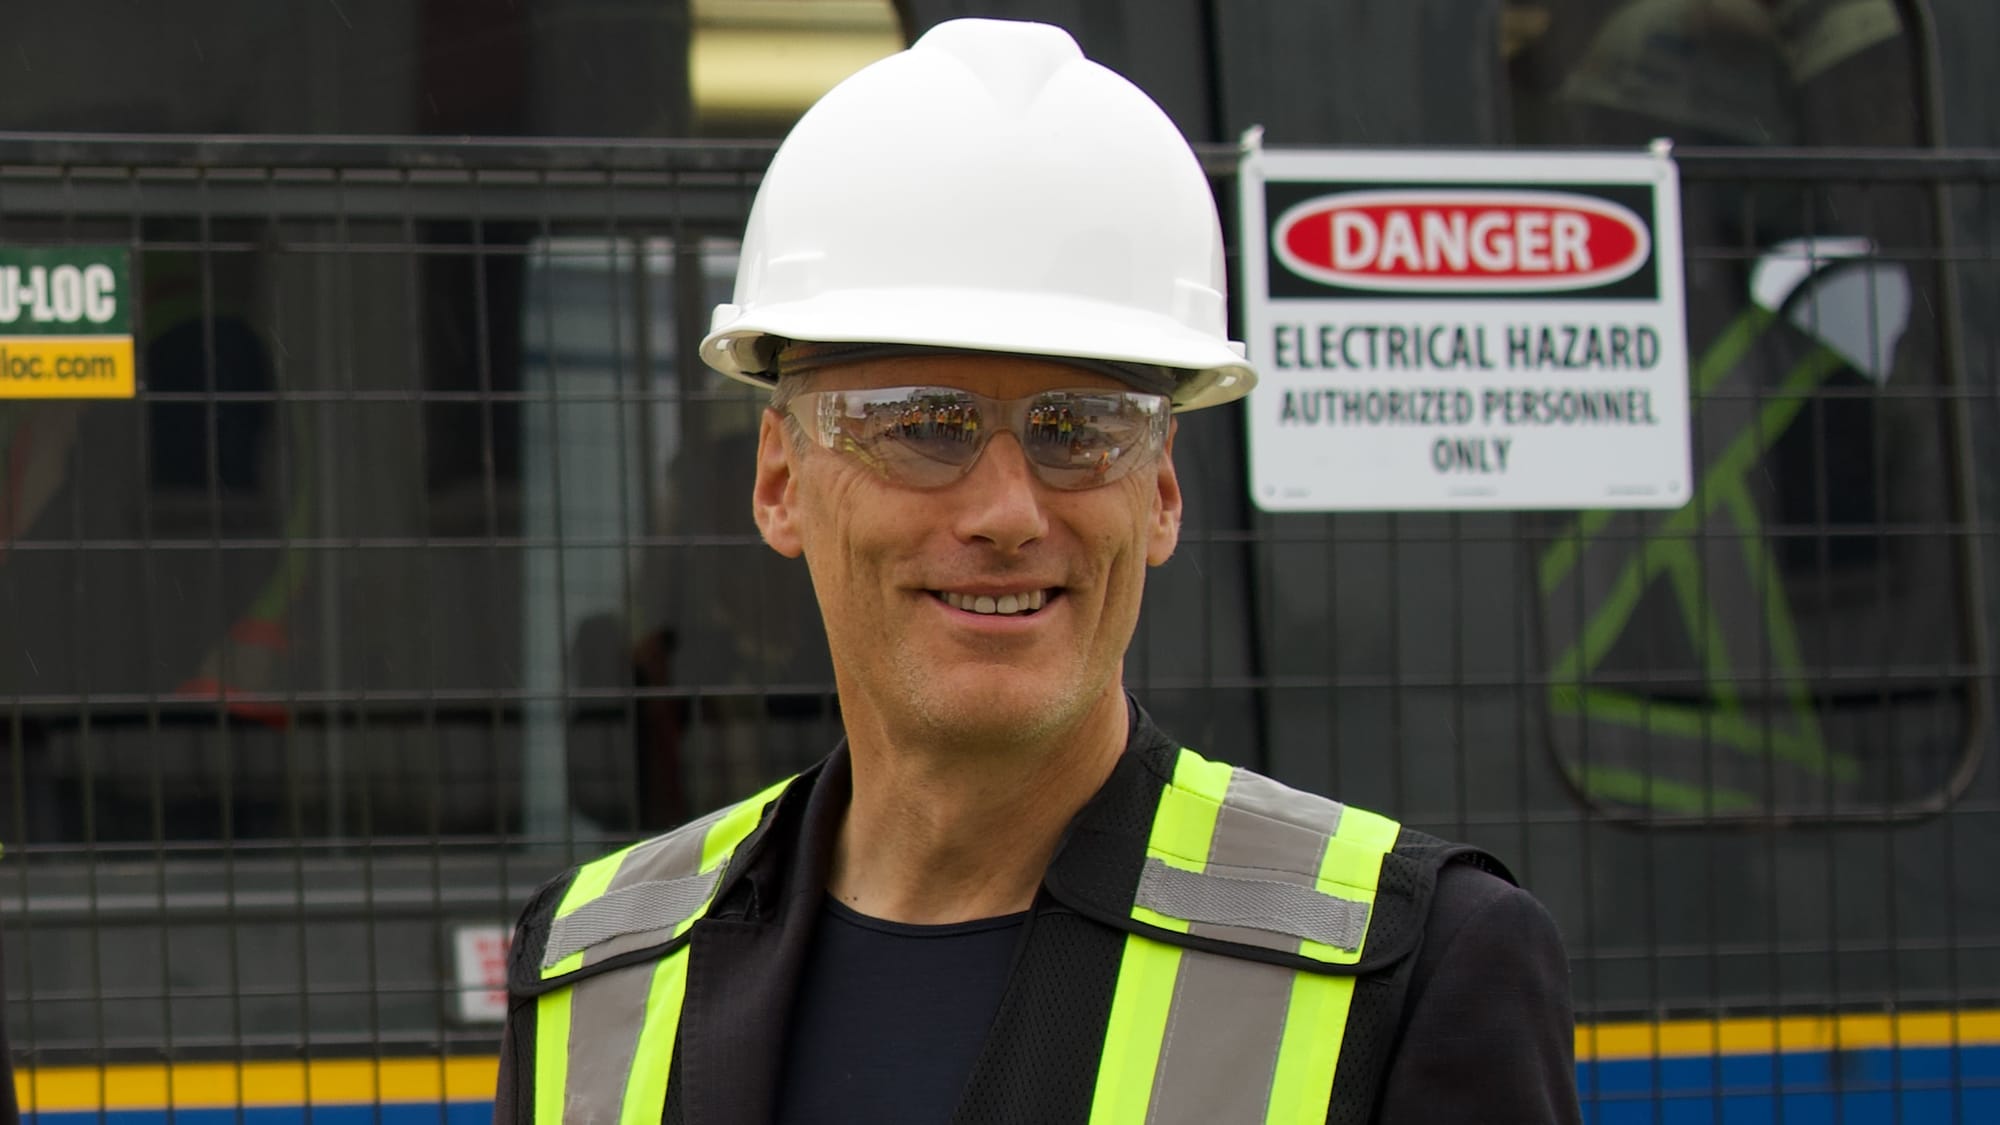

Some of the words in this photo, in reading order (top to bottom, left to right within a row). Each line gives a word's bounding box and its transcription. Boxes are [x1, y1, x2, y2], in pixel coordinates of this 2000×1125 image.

[1332, 211, 1592, 272] DANGER
[1274, 326, 1494, 370] ELECTRICAL
[1507, 326, 1659, 370] HAZARD
[1280, 389, 1473, 425] AUTHORIZED
[1483, 389, 1658, 425] PERSONNEL
[1431, 438, 1511, 473] ONLY
